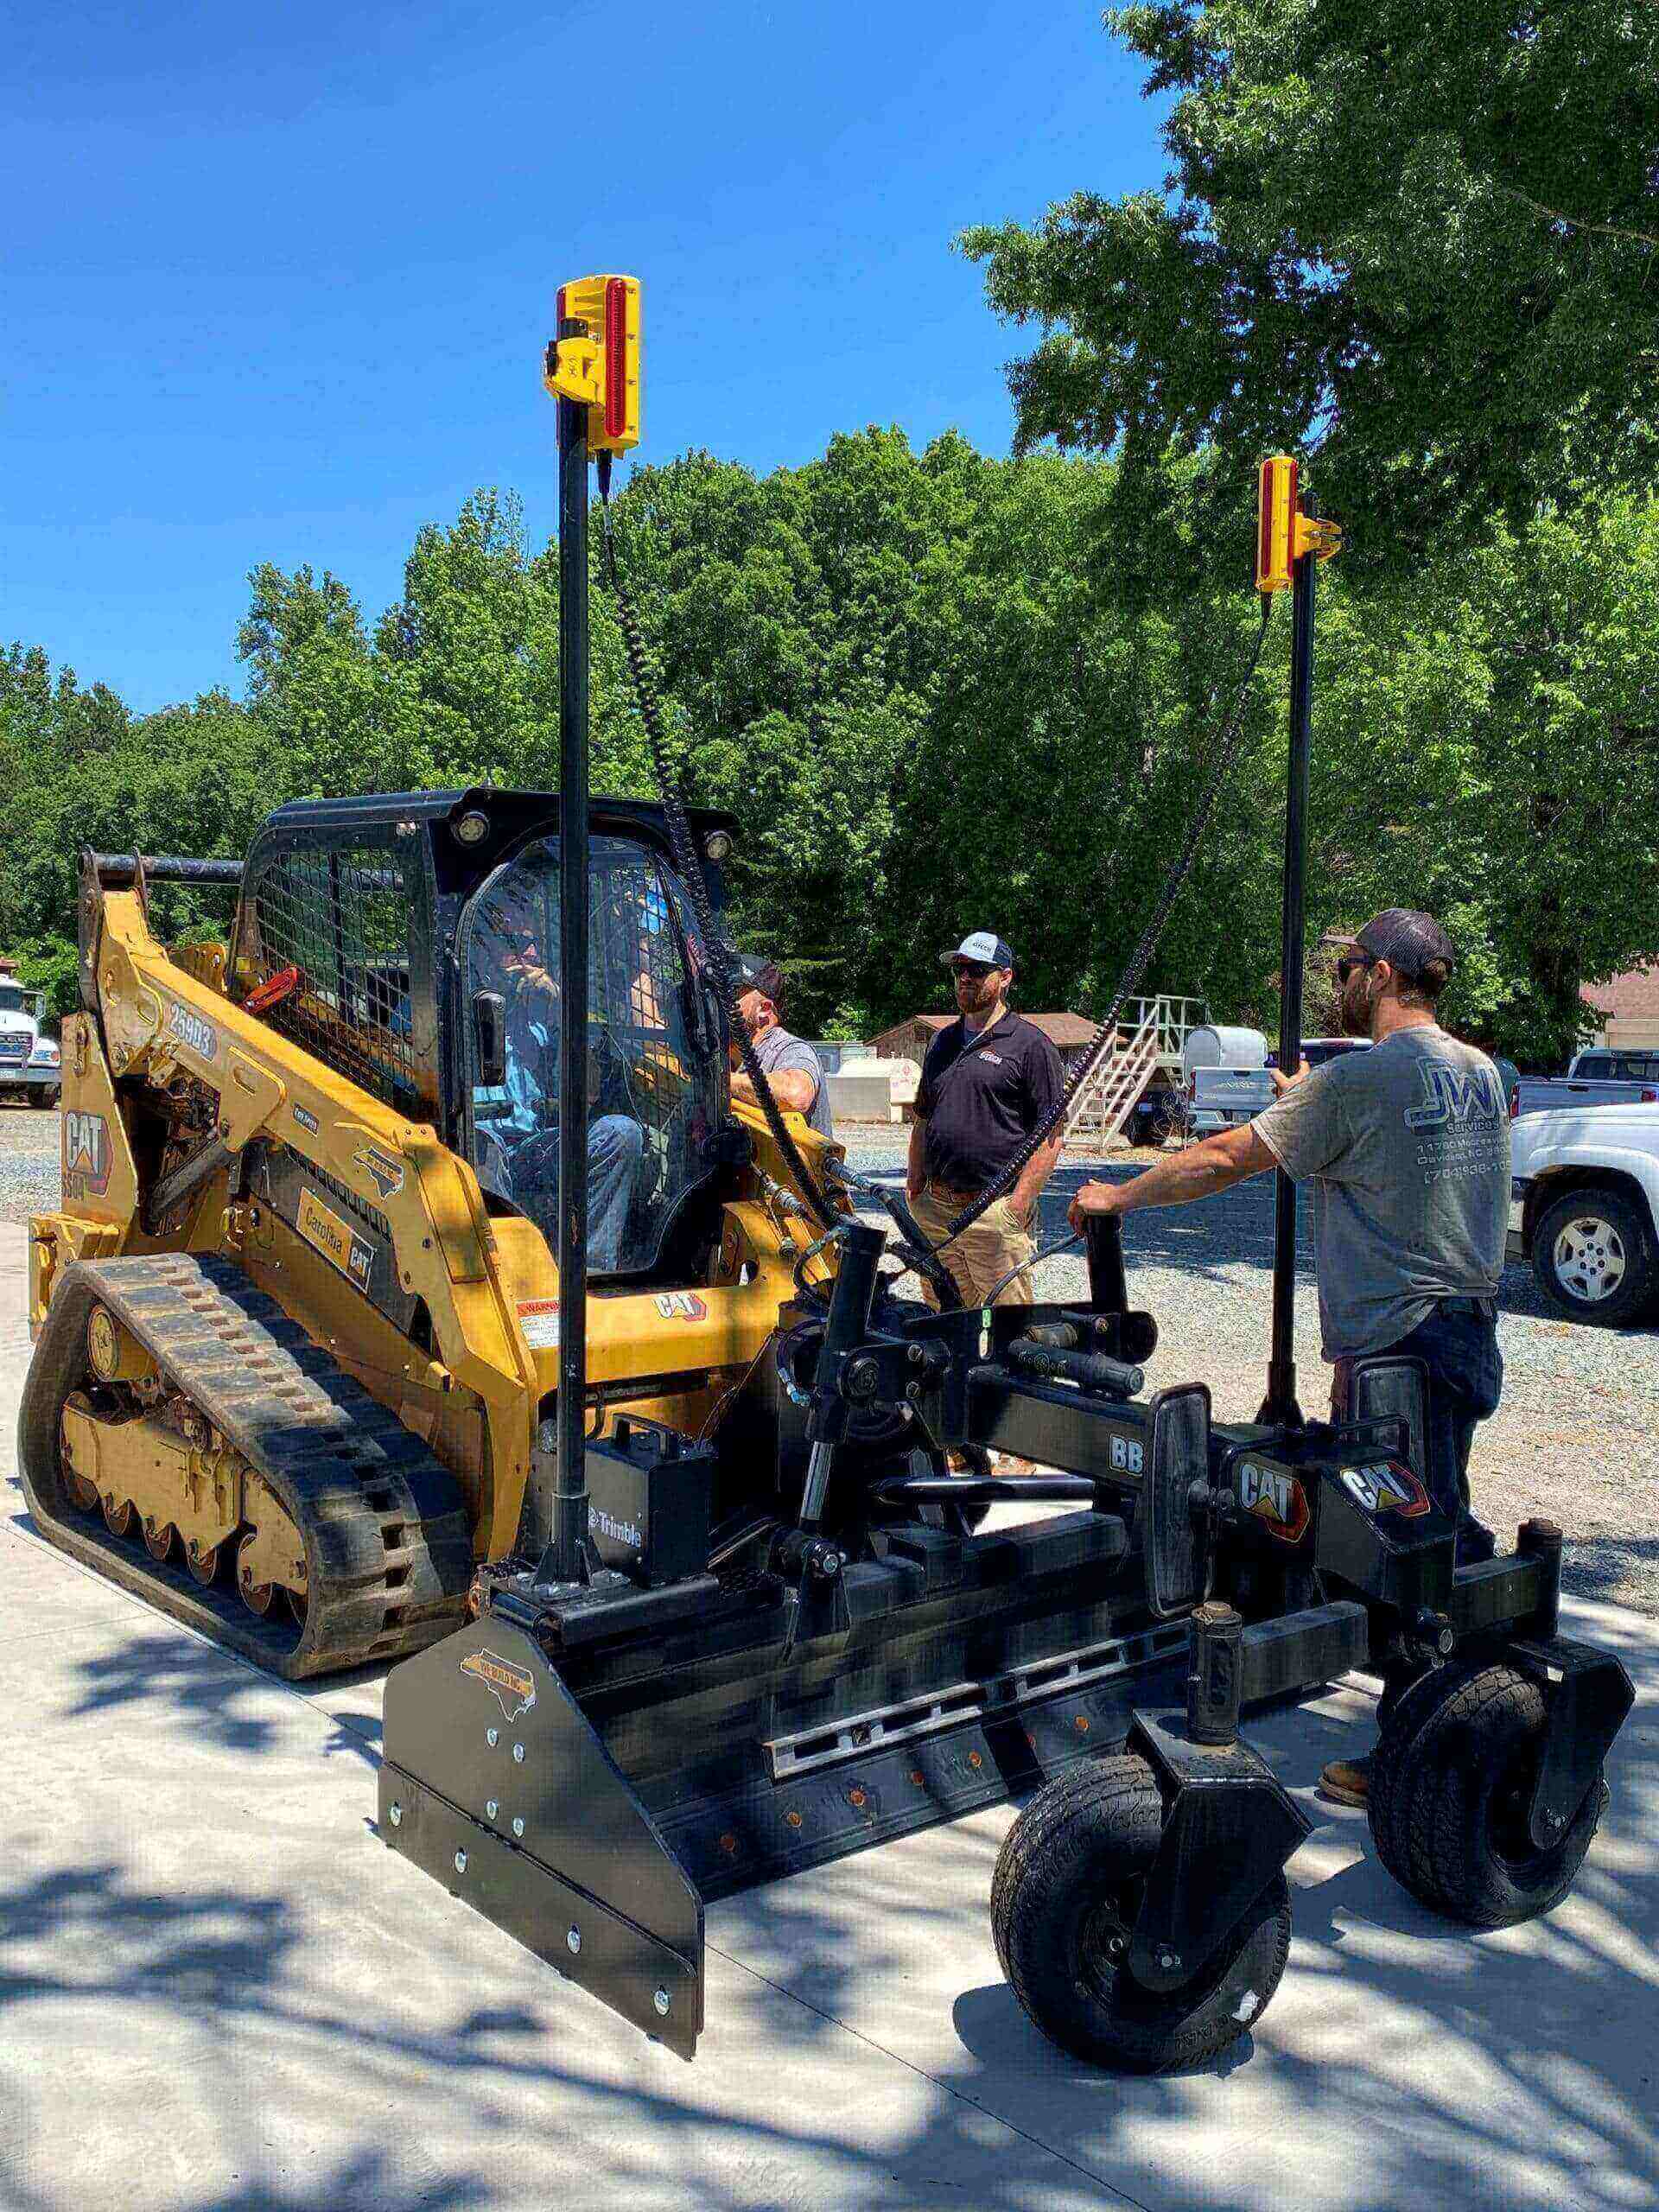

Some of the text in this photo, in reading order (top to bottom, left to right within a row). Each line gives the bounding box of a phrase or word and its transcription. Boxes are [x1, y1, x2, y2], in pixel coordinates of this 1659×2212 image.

[67, 1112, 102, 1176] CAT
[1446, 1116, 1499, 1135] Services
[305, 1205, 370, 1278] Carolina CAT
[656, 1294, 696, 1318] CAT
[1109, 1435, 1145, 1474] BB
[1240, 1464, 1294, 1523] CAT
[1340, 1465, 1410, 1510] CAT
[601, 1510, 642, 1548] Trimble
